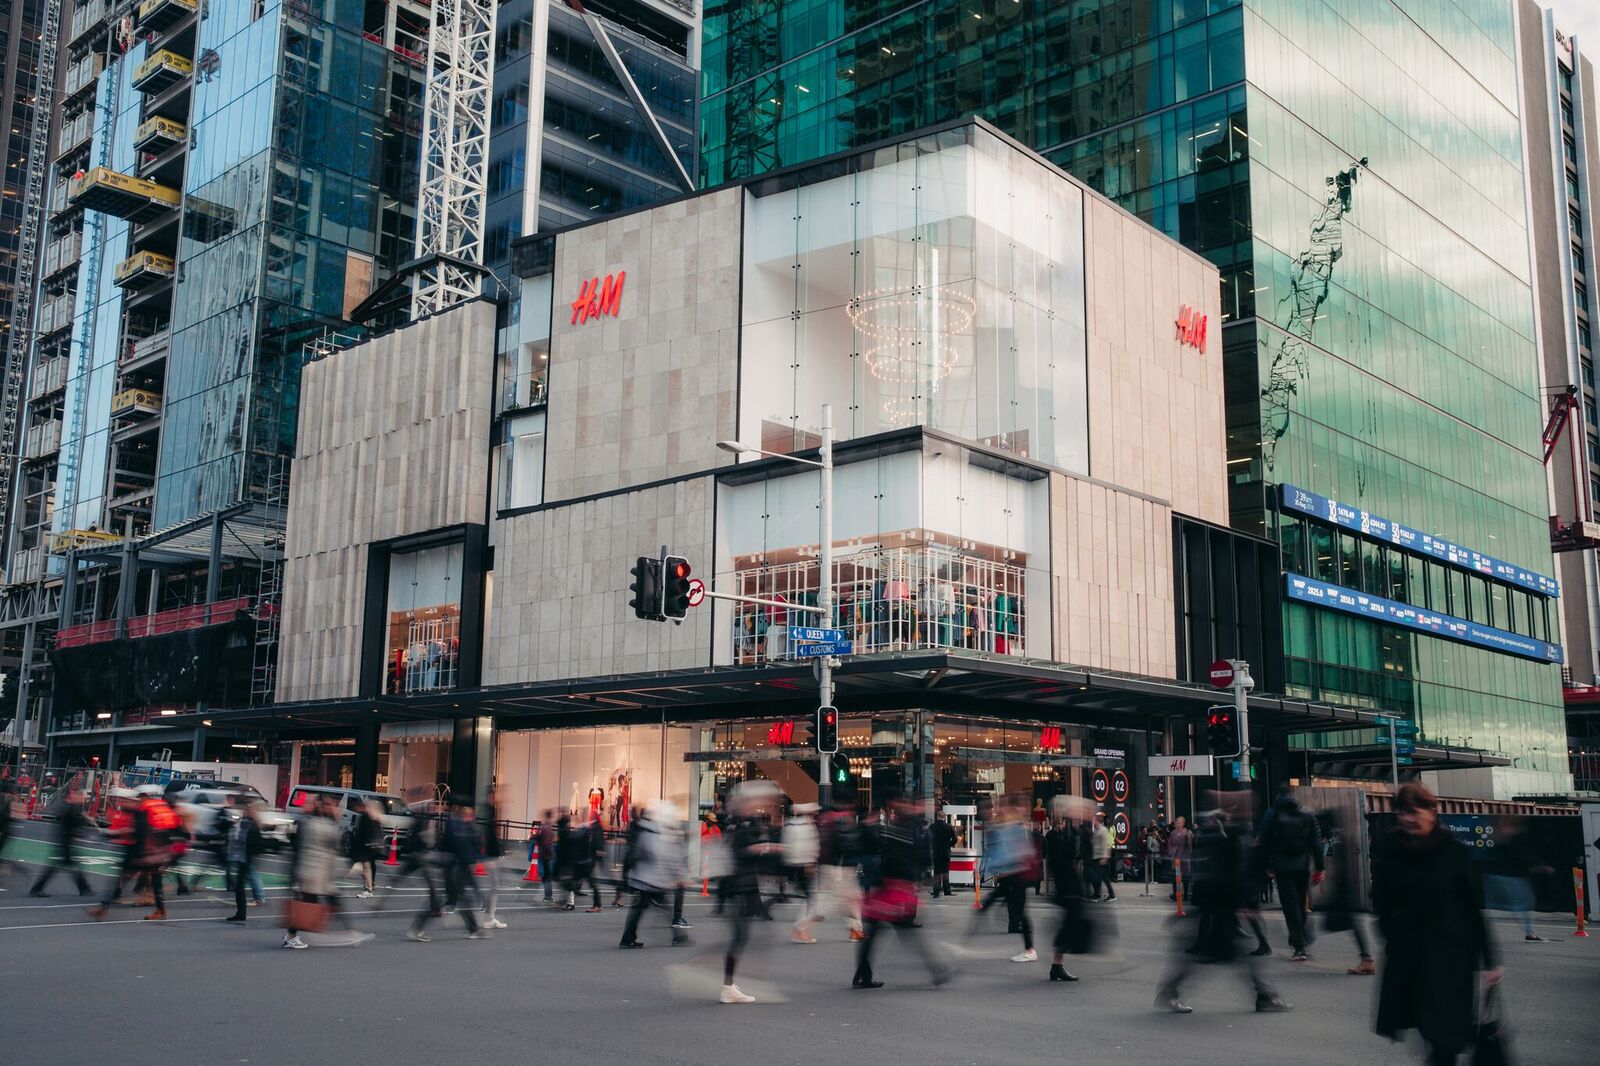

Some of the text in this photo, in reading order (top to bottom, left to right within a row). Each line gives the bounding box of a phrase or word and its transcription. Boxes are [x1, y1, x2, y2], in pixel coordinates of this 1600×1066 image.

[571, 270, 626, 326] H&M
[1175, 303, 1207, 355] H&M
[806, 629, 824, 639] QUEEN
[810, 644, 835, 655] CUSTOMS
[1108, 749, 1125, 757] OPENING
[1169, 759, 1186, 772] H&M
[1095, 780, 1125, 791] 00 02
[1116, 822, 1126, 833] 08
[1449, 824, 1470, 832] Trains
